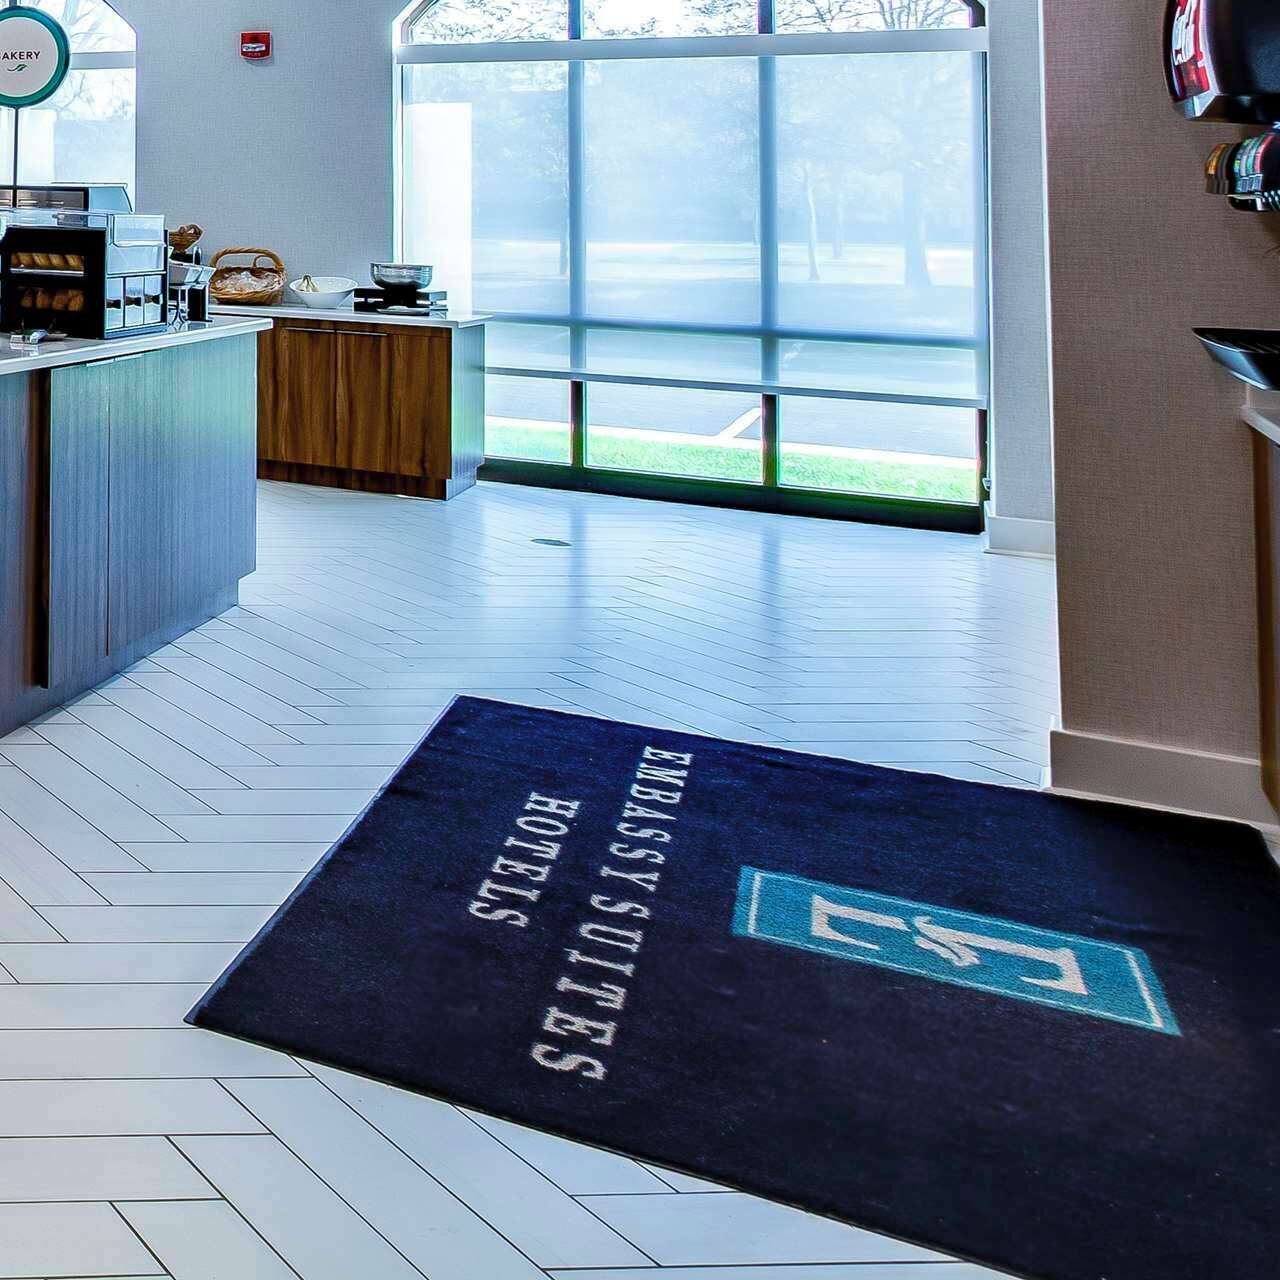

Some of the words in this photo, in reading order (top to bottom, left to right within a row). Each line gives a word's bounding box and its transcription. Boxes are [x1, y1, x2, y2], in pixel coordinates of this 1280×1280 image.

[468, 791, 582, 928] HOTELS
[600, 745, 694, 893] EMBASSY
[530, 894, 651, 1081] SUITES
